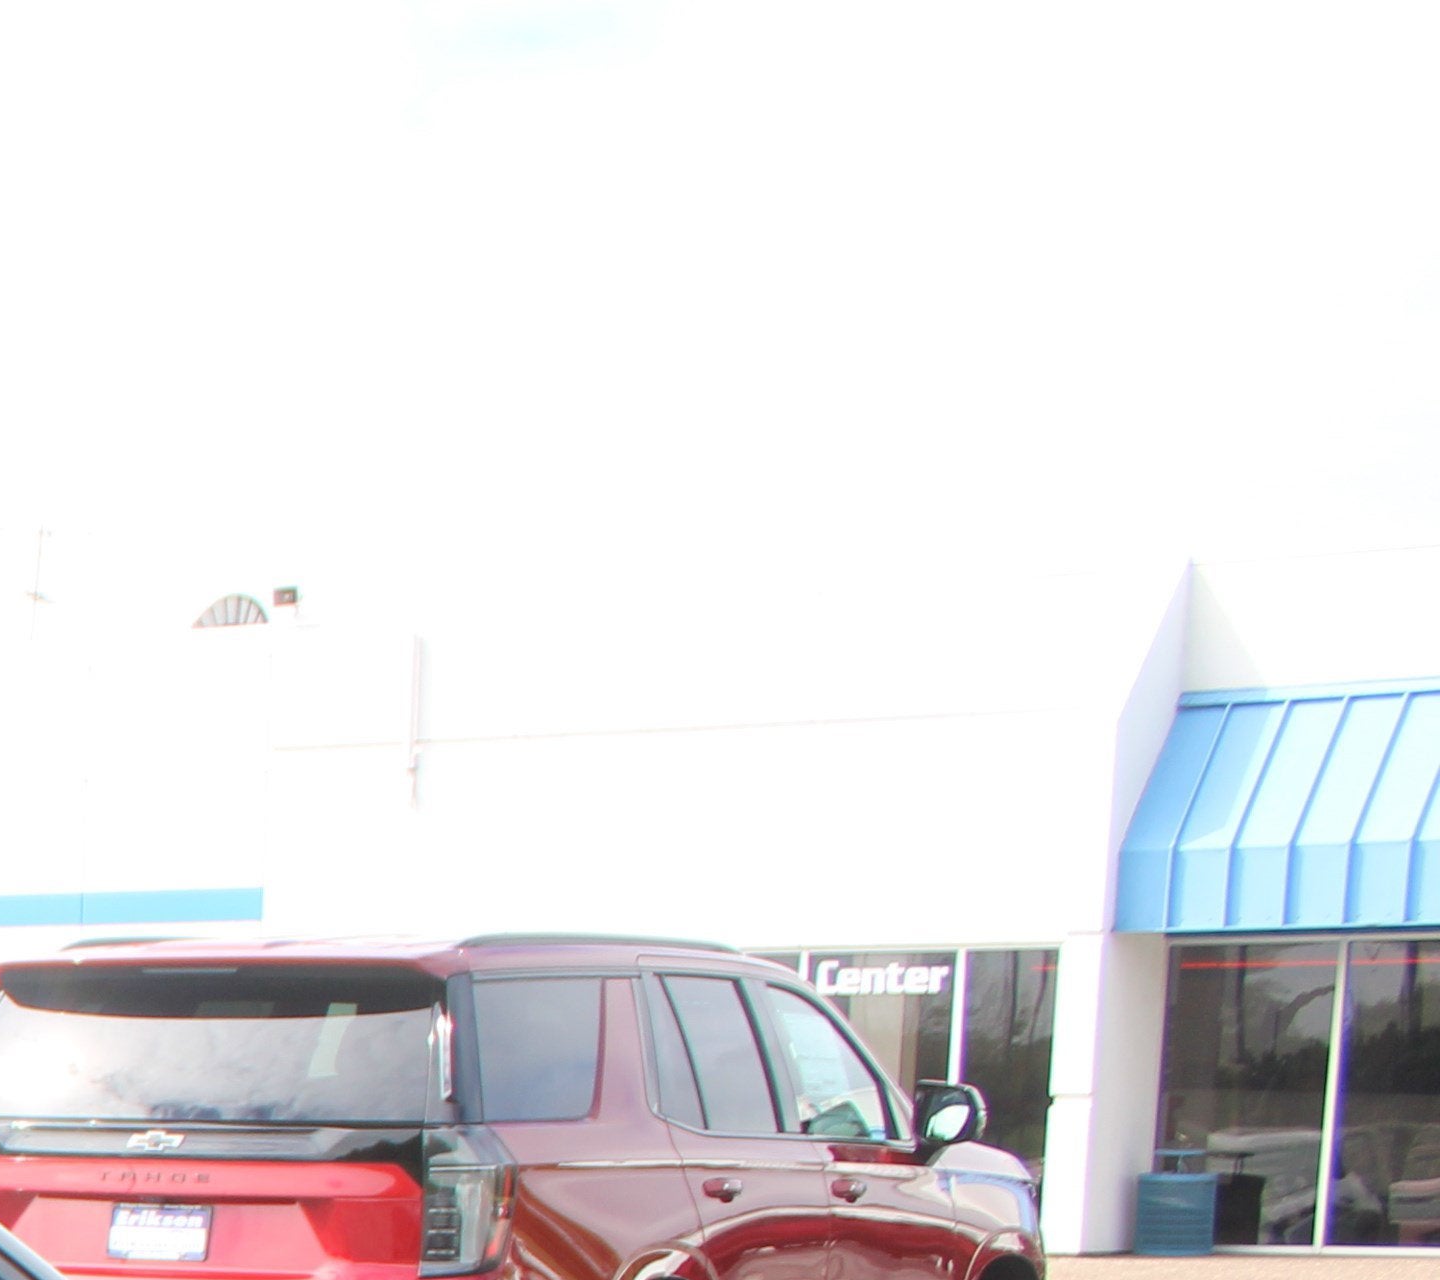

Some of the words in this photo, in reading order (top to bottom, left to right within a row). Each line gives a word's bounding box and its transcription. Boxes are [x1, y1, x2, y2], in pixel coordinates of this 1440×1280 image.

[815, 959, 949, 995] Center
[99, 1170, 211, 1184] TAHOE
[114, 1209, 204, 1229] Eriksen
